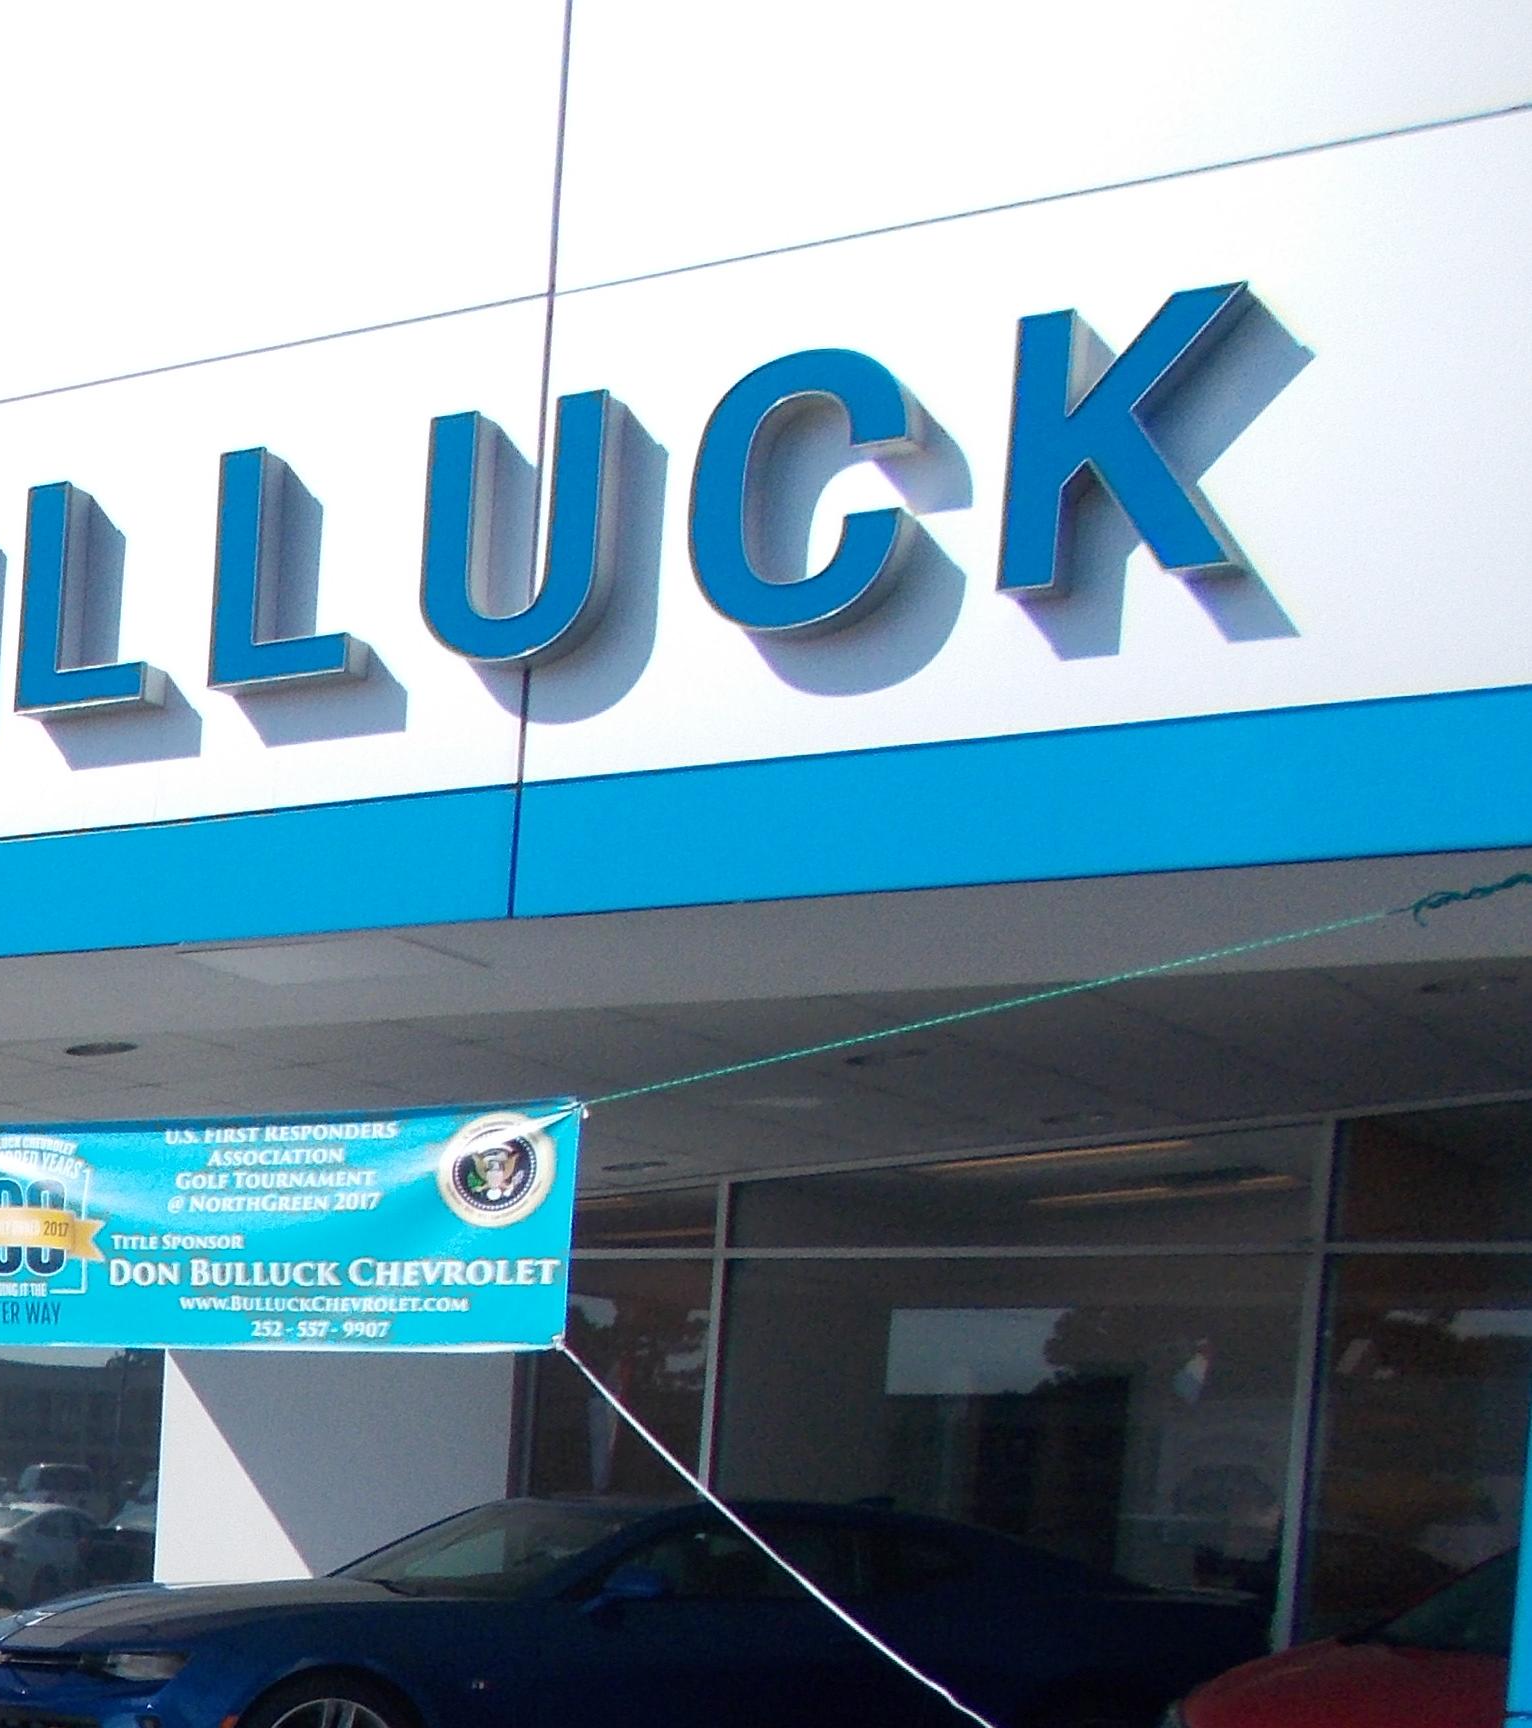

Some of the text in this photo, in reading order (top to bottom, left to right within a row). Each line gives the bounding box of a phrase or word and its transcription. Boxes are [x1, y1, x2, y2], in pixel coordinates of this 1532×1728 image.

[165, 1121, 398, 1145] U.S. FIRST RESPONDERS
[207, 1147, 344, 1167] ASSOCIATION
[175, 1170, 376, 1190] GOLF TOURNAMENT
[168, 1197, 182, 1213] @
[335, 1192, 380, 1210] 2017
[43, 1220, 69, 1237] 2017
[110, 1233, 244, 1251] TITLE SPONSOR
[109, 1257, 561, 1287] DON BULLUCK CHEVROLET
[25, 1301, 61, 1326] WAY
